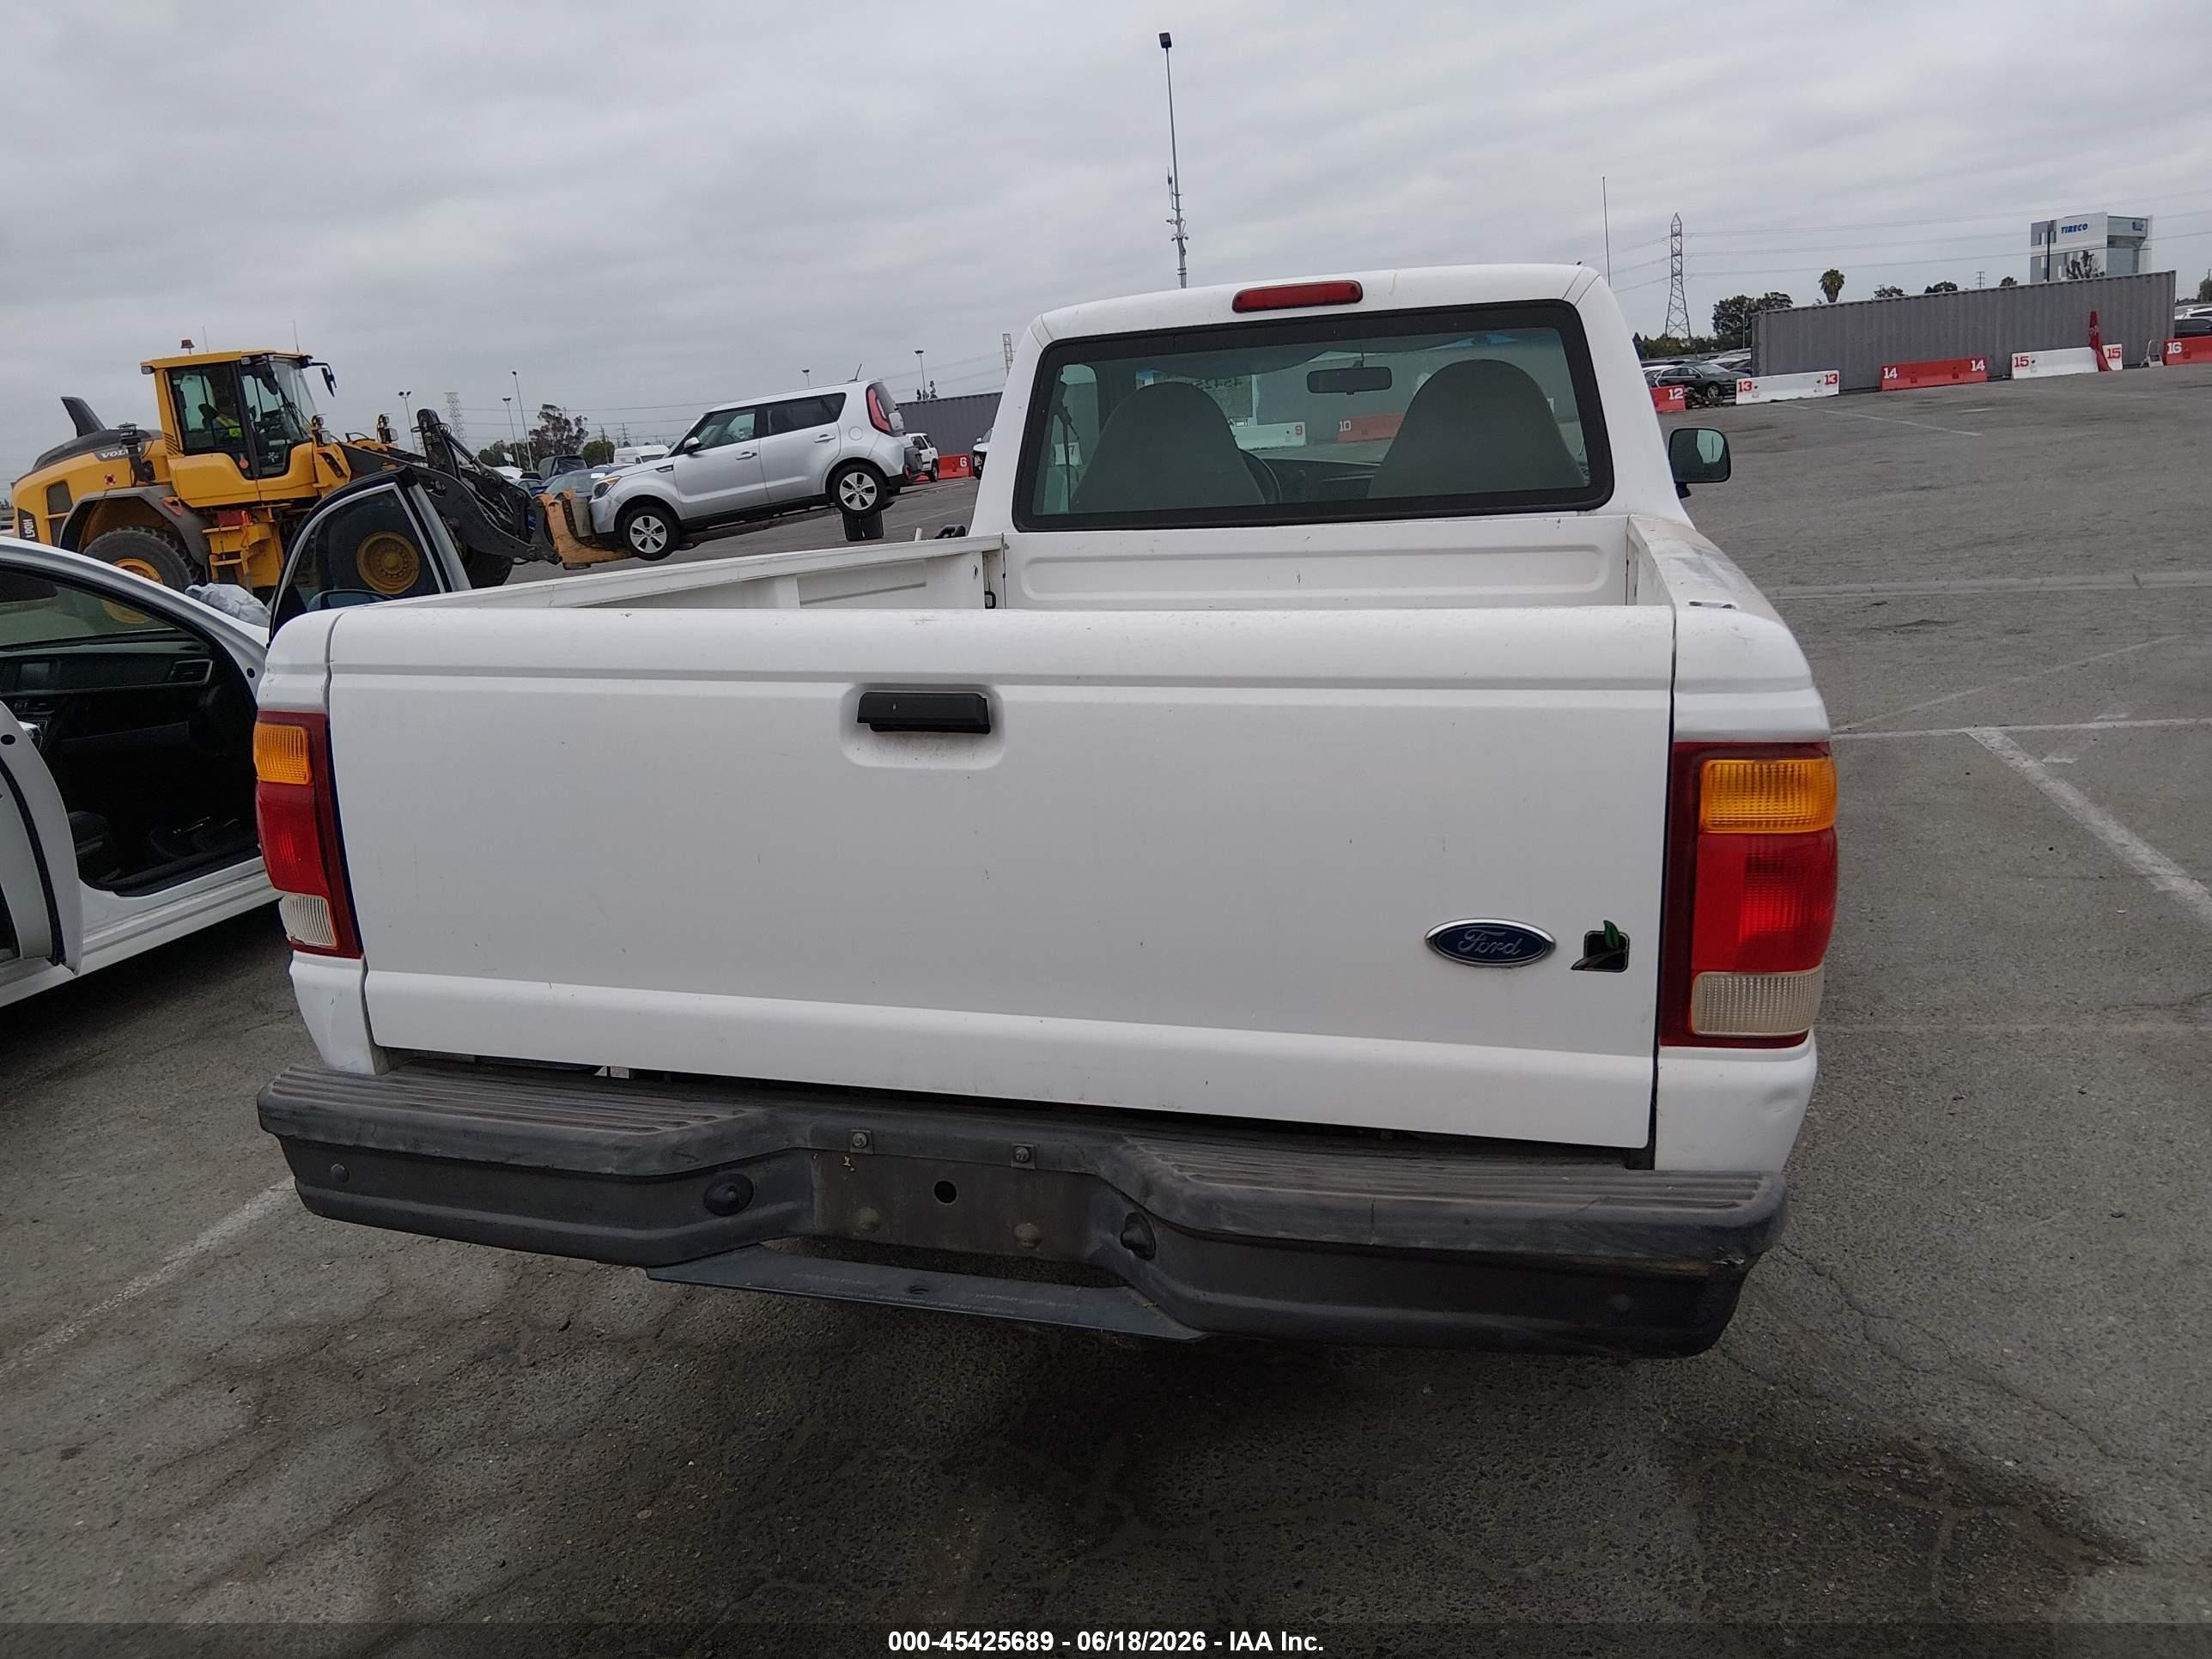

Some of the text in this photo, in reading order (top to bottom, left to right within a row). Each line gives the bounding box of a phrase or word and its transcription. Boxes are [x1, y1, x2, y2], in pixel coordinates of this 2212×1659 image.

[2061, 223, 2088, 234] TIRECO
[2106, 348, 2121, 359] 15
[2166, 342, 2182, 355] 16
[1971, 360, 1985, 371] 14
[2014, 356, 2029, 368] 15
[1824, 374, 1838, 385] 13
[1883, 368, 1898, 379] 14
[1738, 380, 1753, 392] 13
[1668, 388, 1684, 400] 12
[1295, 425, 1303, 435] 9
[1339, 420, 1352, 432] 10
[22, 519, 35, 538] L90H
[1459, 928, 1523, 956] Ford
